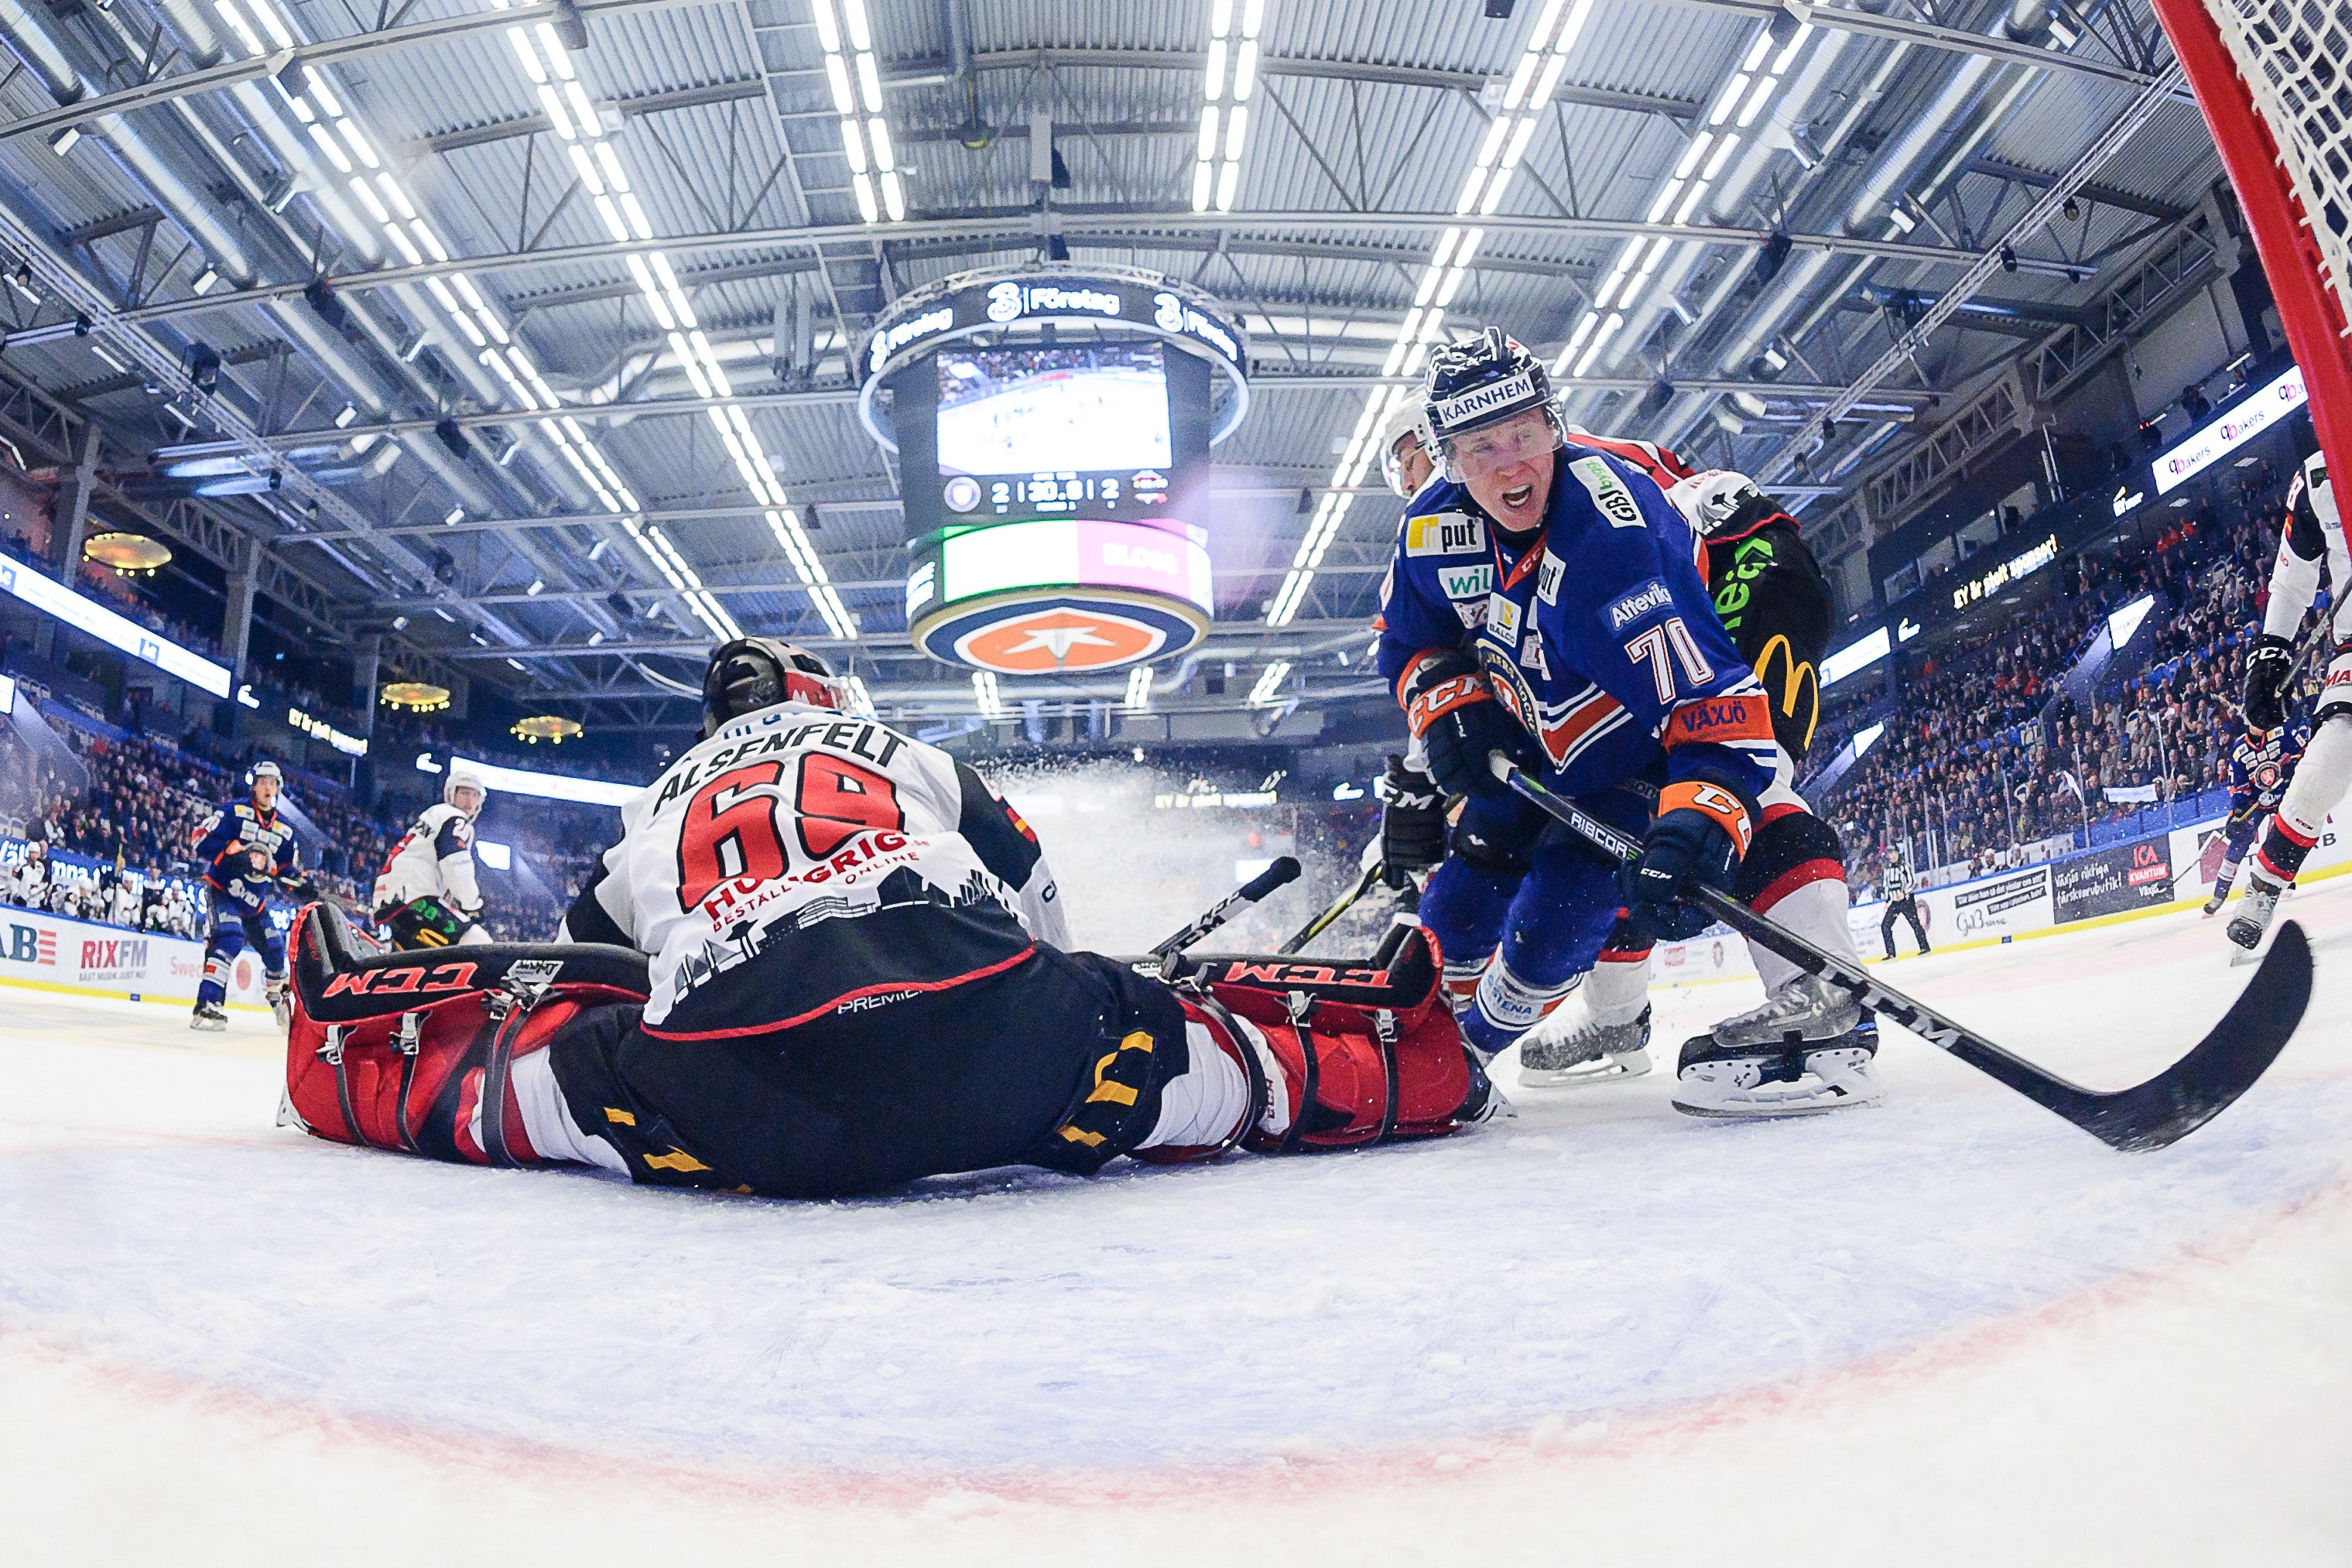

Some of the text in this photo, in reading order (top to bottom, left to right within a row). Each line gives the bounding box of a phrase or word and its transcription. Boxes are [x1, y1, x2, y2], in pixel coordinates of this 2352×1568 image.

[1030, 288, 1121, 316] Företag
[1101, 478, 1120, 499] 2
[1597, 489, 1637, 522] GBJ
[1441, 518, 1477, 553] put
[1624, 616, 1716, 706] 70
[1680, 699, 1748, 733] VÄXJÖ
[652, 722, 909, 817] ALSENFELT
[676, 750, 906, 914] 69
[845, 851, 920, 884] ONLINE
[2133, 844, 2159, 868] ICA
[704, 831, 907, 921] HUGRIG
[1640, 867, 1672, 880] CCM
[2128, 865, 2166, 883] KVANTUM
[322, 961, 478, 998] CCM
[1224, 960, 1393, 988] CCM
